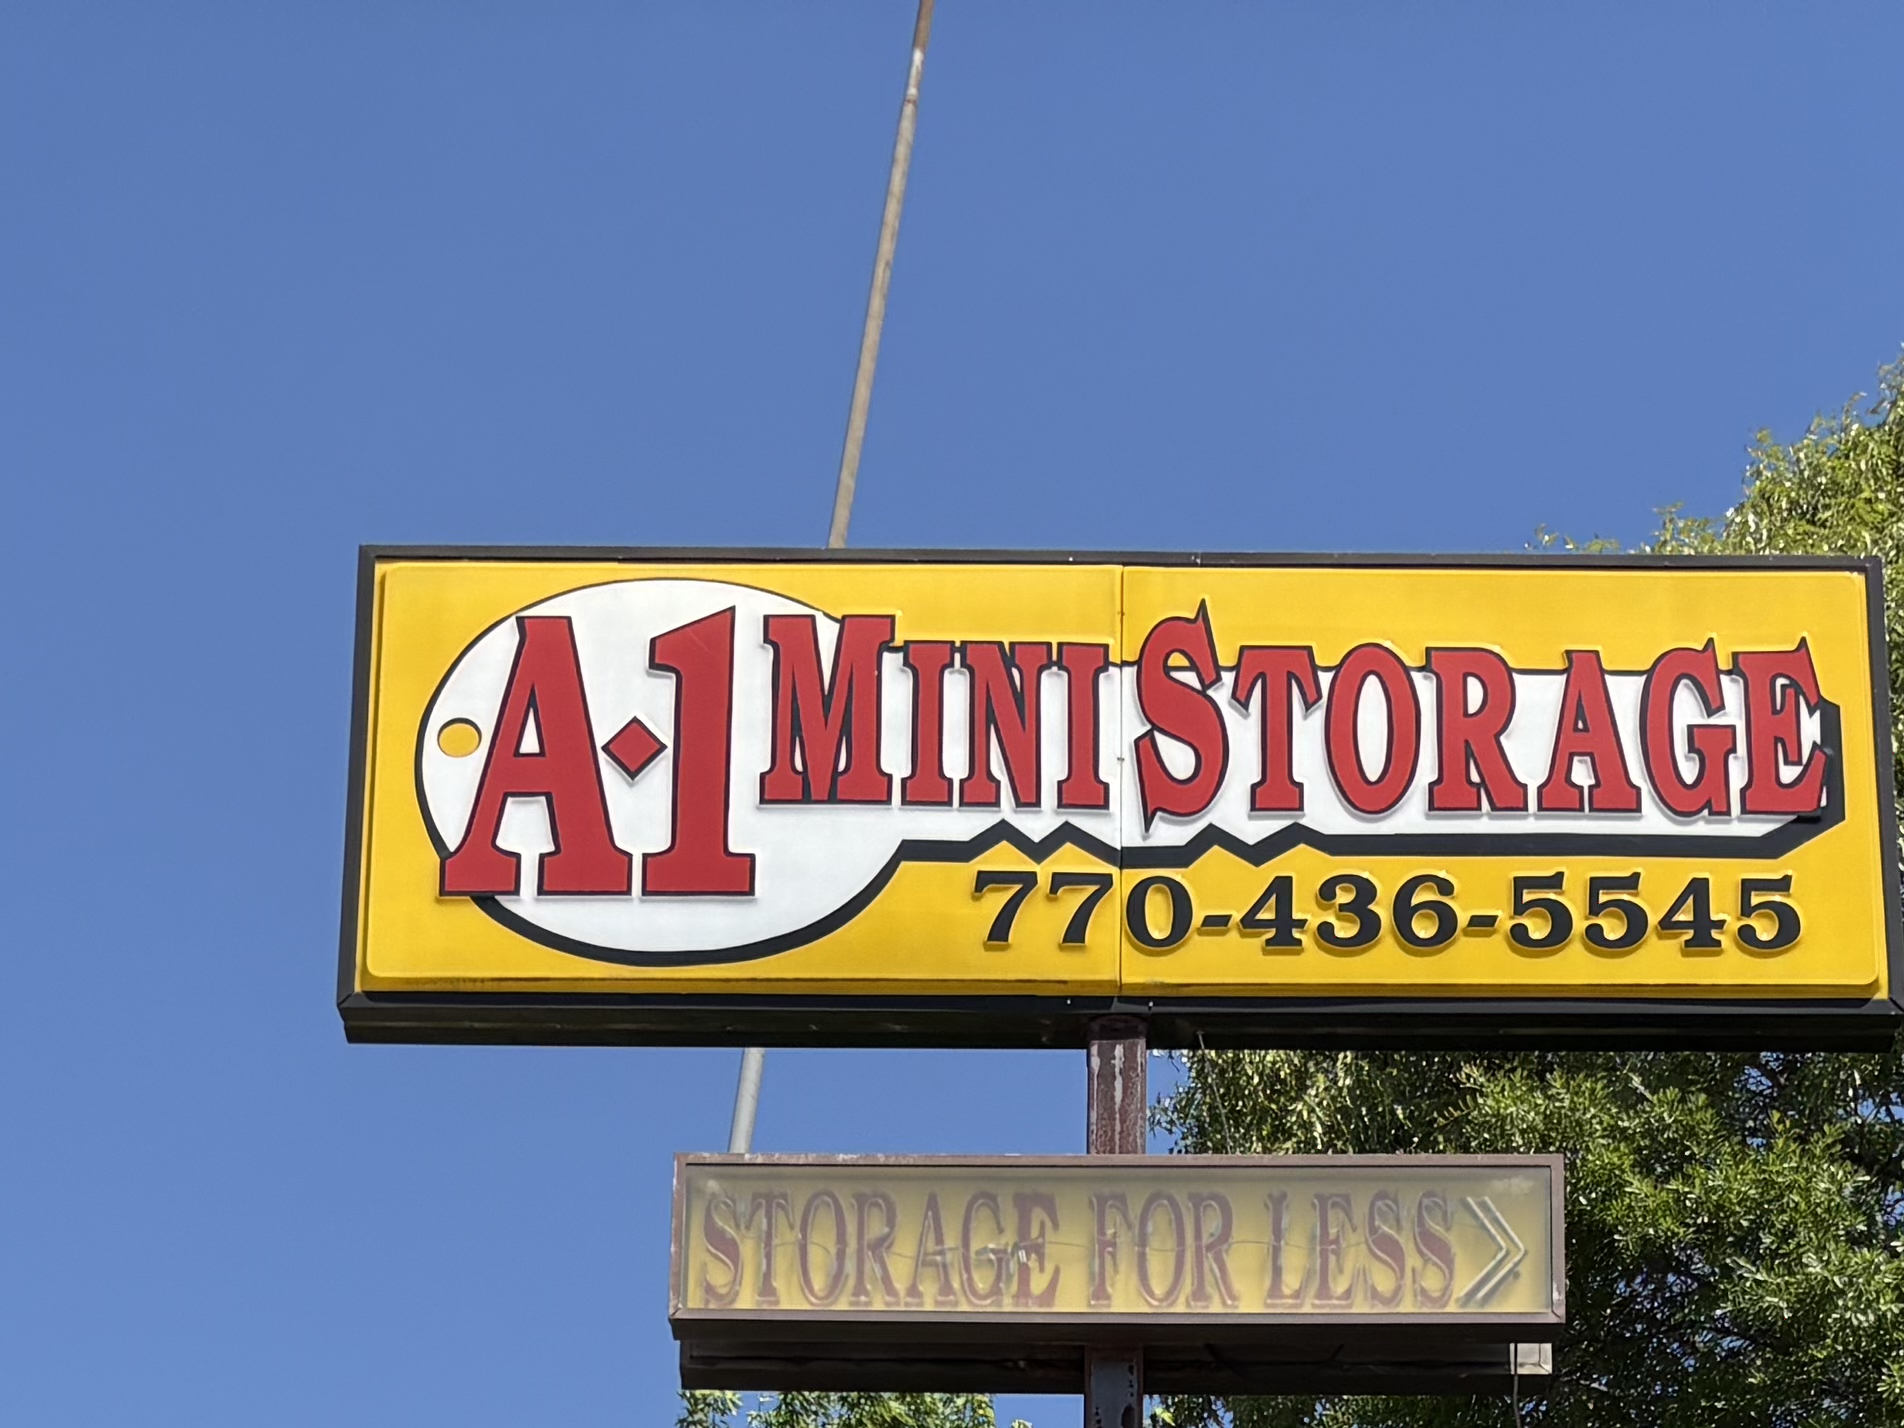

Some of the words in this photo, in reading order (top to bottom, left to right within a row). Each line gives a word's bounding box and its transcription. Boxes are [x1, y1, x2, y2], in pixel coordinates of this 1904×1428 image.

[758, 612, 1112, 812] MINI
[1134, 598, 1828, 834] STORAGE
[973, 869, 1803, 954] 770-436-5545
[701, 1189, 1061, 1309] STORAGE
[1090, 1189, 1237, 1309] FOR
[1265, 1189, 1456, 1309] LESS
